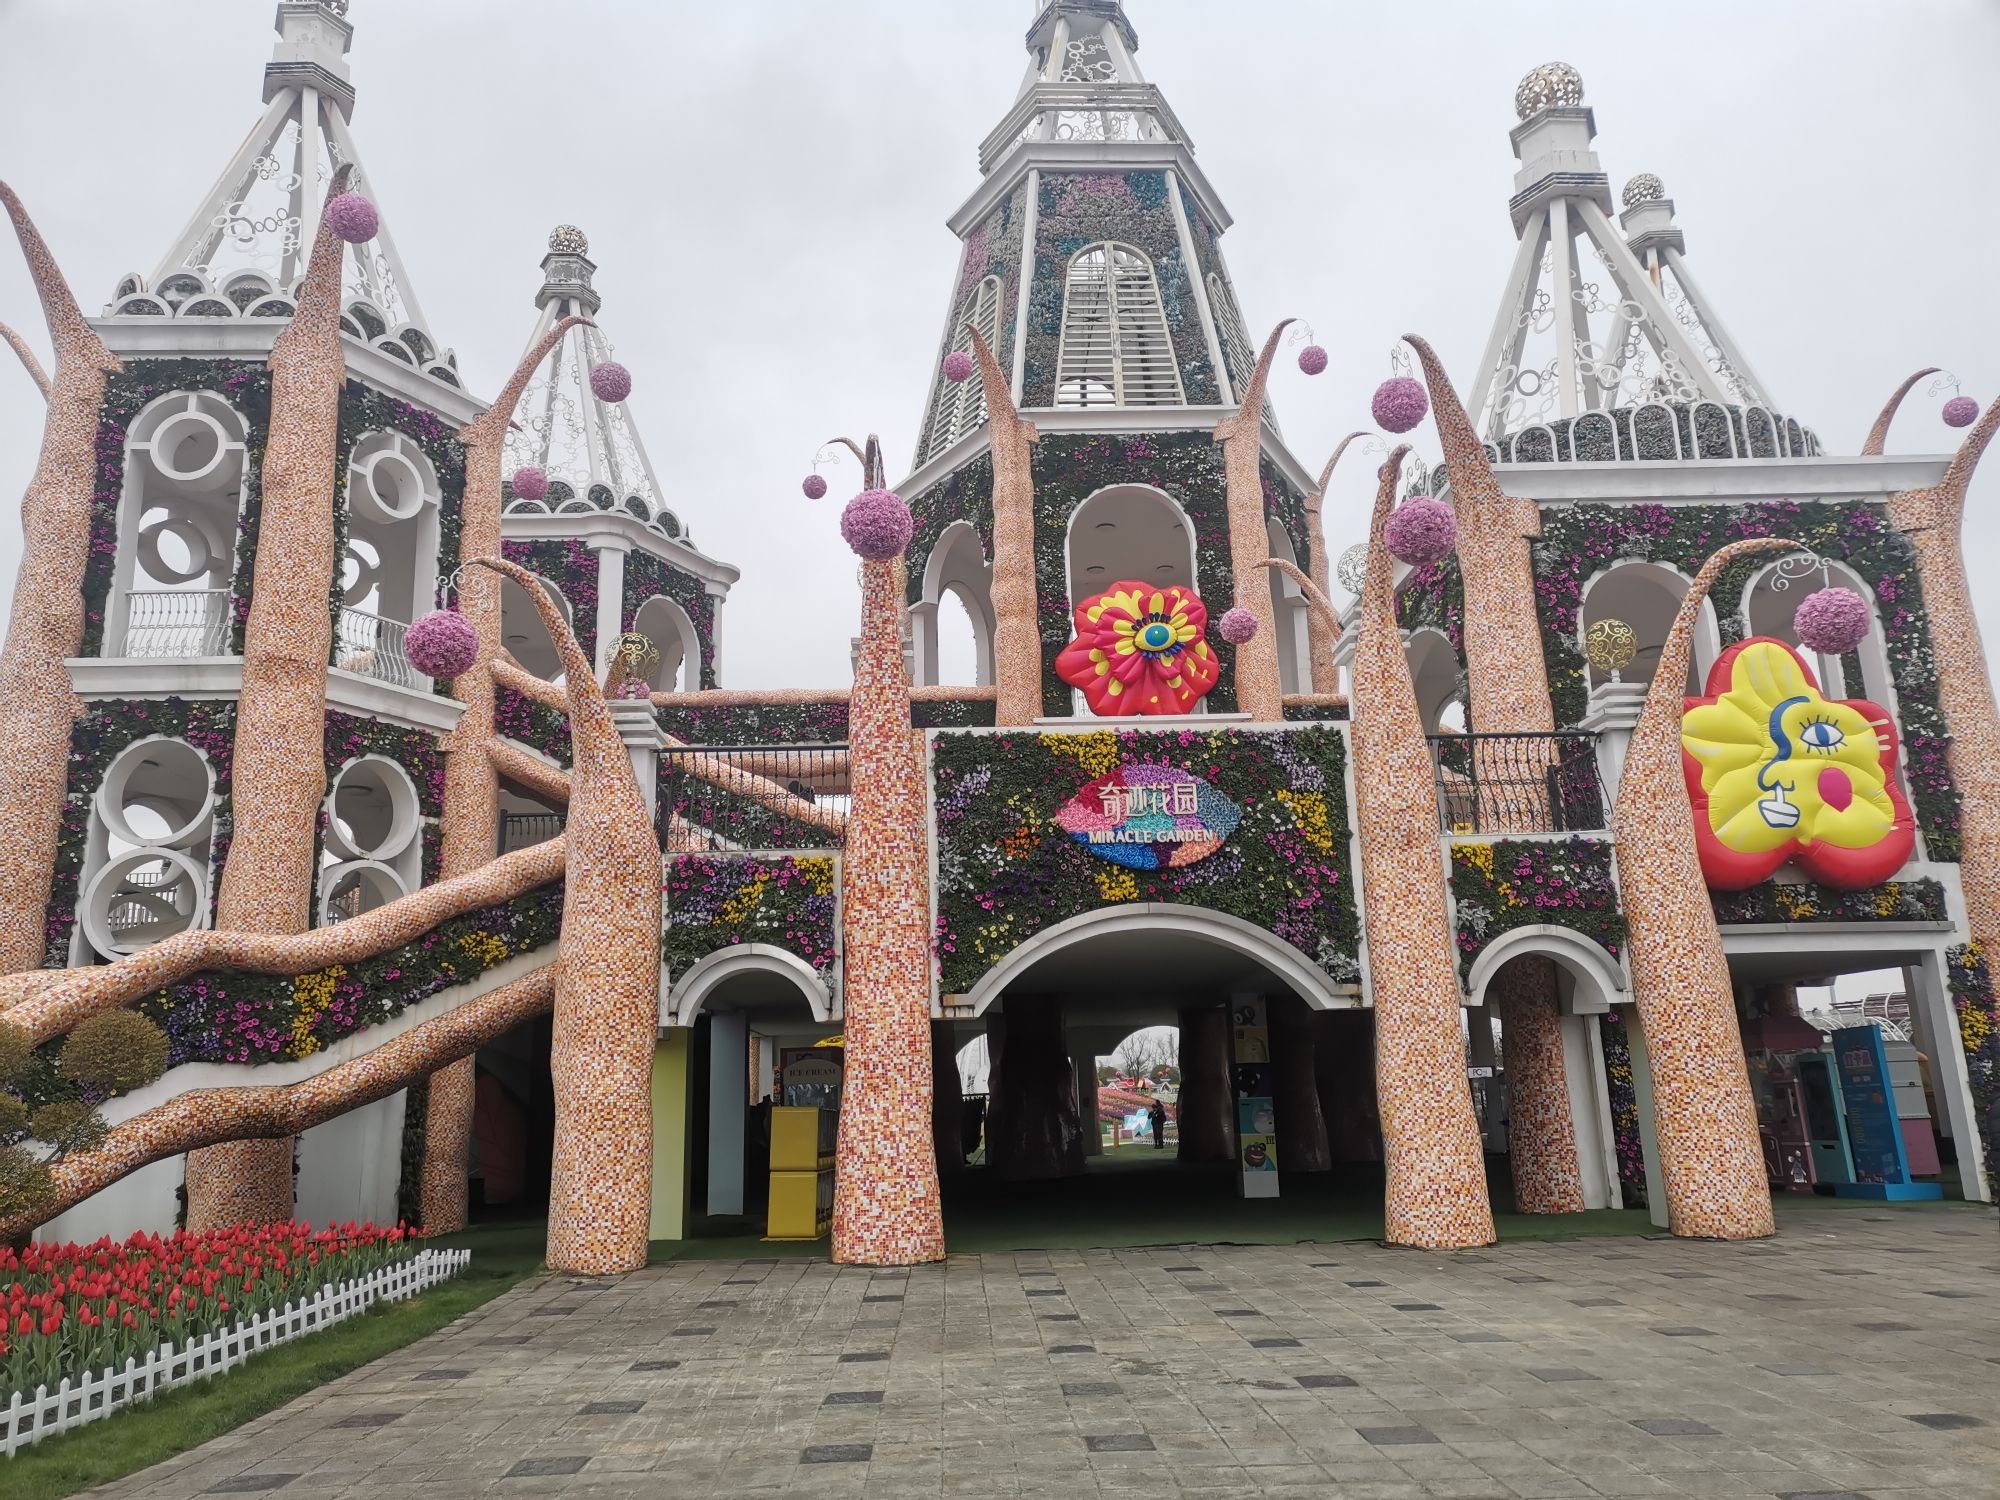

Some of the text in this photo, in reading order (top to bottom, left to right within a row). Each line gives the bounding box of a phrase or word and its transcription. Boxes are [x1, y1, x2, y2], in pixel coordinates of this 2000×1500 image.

[1098, 781, 1198, 825] 奇迹花园
[1089, 829, 1214, 844] MIRACLE GARDEN
[806, 1068, 837, 1076] CREAM
